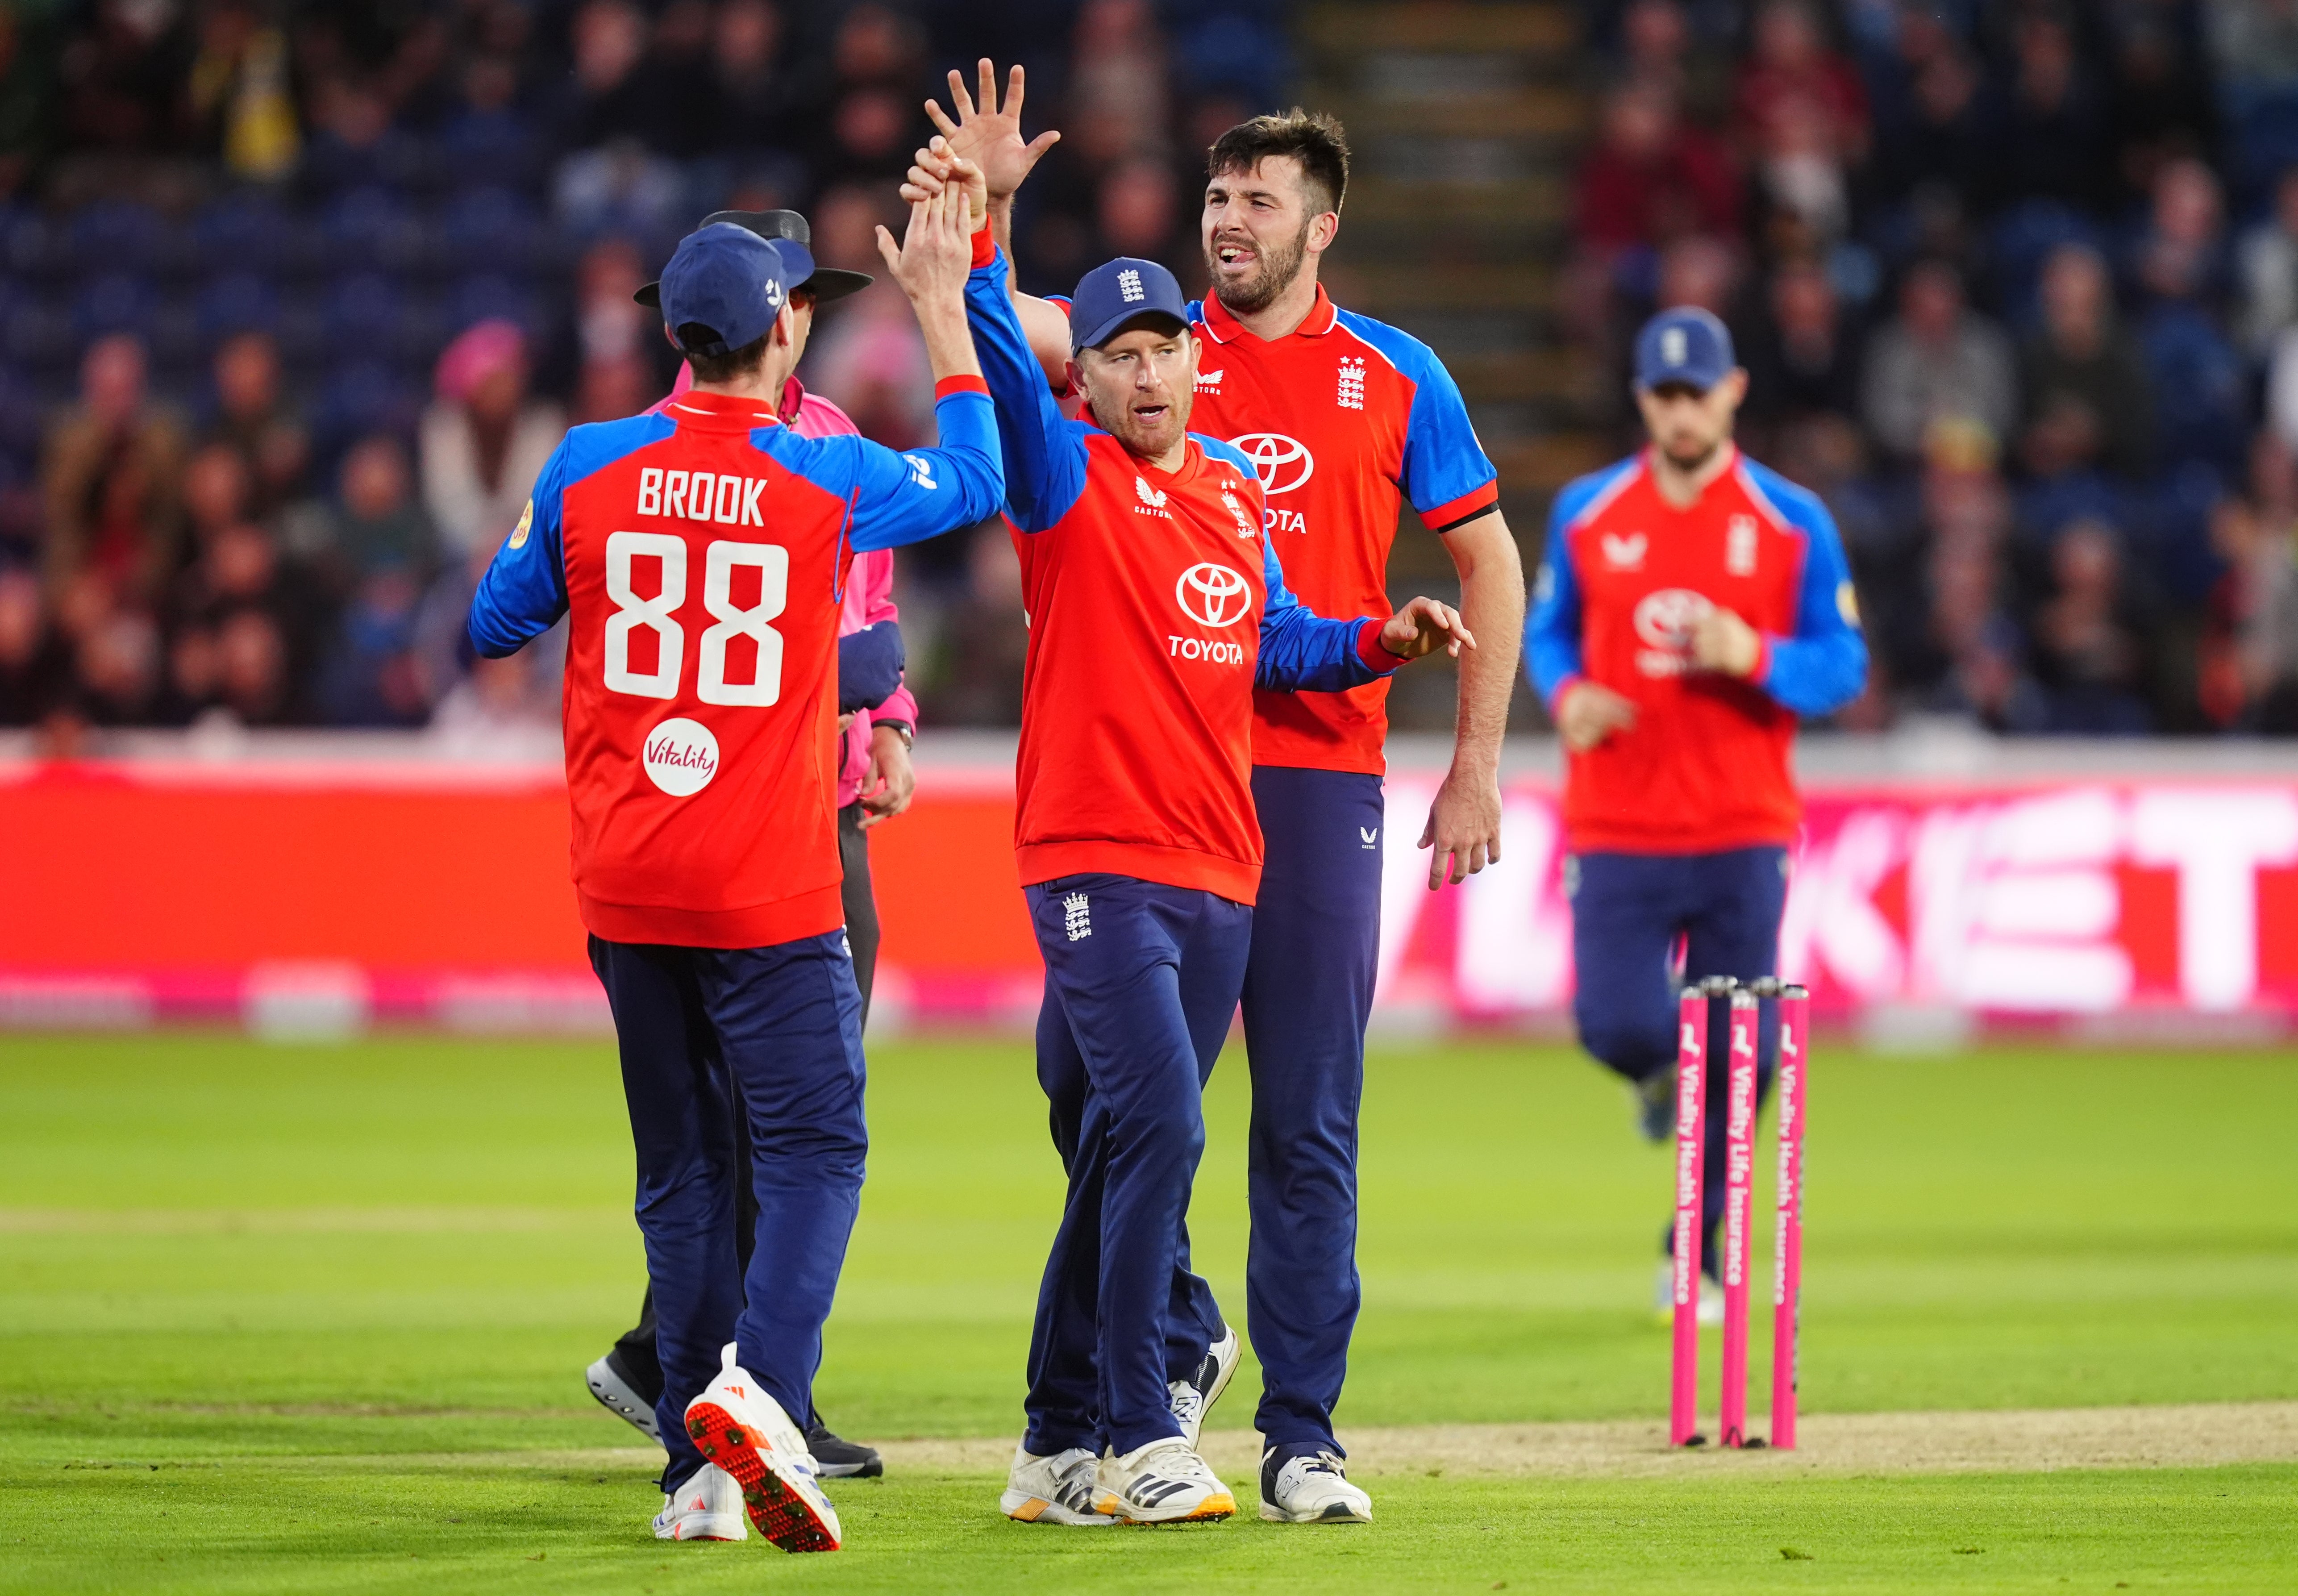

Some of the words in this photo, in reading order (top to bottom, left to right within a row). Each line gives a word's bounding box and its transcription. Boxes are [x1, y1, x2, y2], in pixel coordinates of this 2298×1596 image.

[1193, 386, 1221, 396] STORE
[637, 467, 768, 527] BROOK
[514, 526, 527, 540] OPS
[1265, 508, 1307, 534] OTA
[604, 531, 789, 707] 88
[1168, 635, 1243, 665] TOYOTA
[649, 737, 715, 779] Vitality
[1677, 1064, 1699, 1137] Vitality
[1727, 1066, 1752, 1140] Vitality
[1679, 1141, 1697, 1206] Health
[1728, 1143, 1749, 1183] Life
